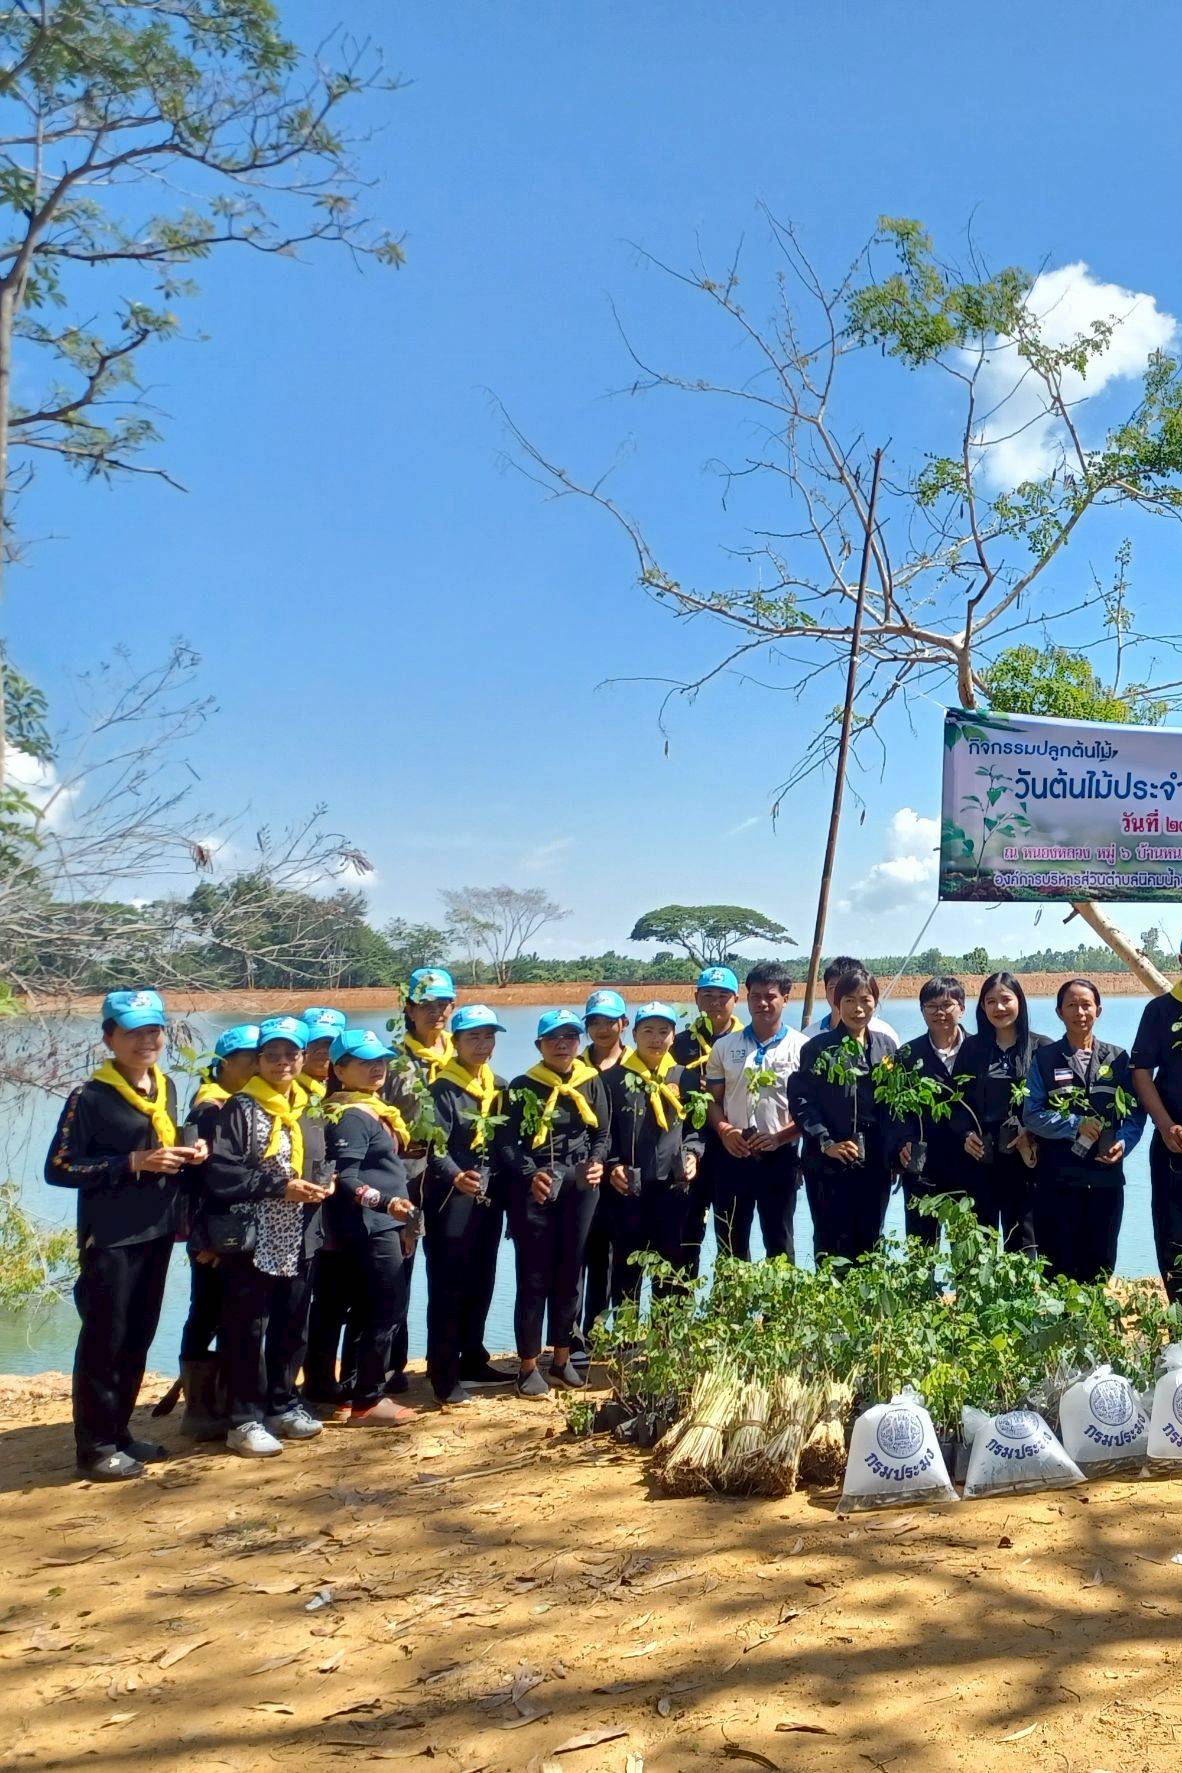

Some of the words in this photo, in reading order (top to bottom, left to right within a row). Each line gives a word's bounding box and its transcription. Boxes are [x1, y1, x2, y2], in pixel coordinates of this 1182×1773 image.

[968, 739, 1112, 762] กิจกรรมปลูกต้นไม้
[1121, 808, 1159, 833] วันที่
[1004, 847, 1017, 860] ณ
[1097, 843, 1115, 864] หมู่
[1120, 847, 1131, 860] ๖
[1084, 1412, 1146, 1447] กรมประมง
[864, 1448, 935, 1482] กรมประมง
